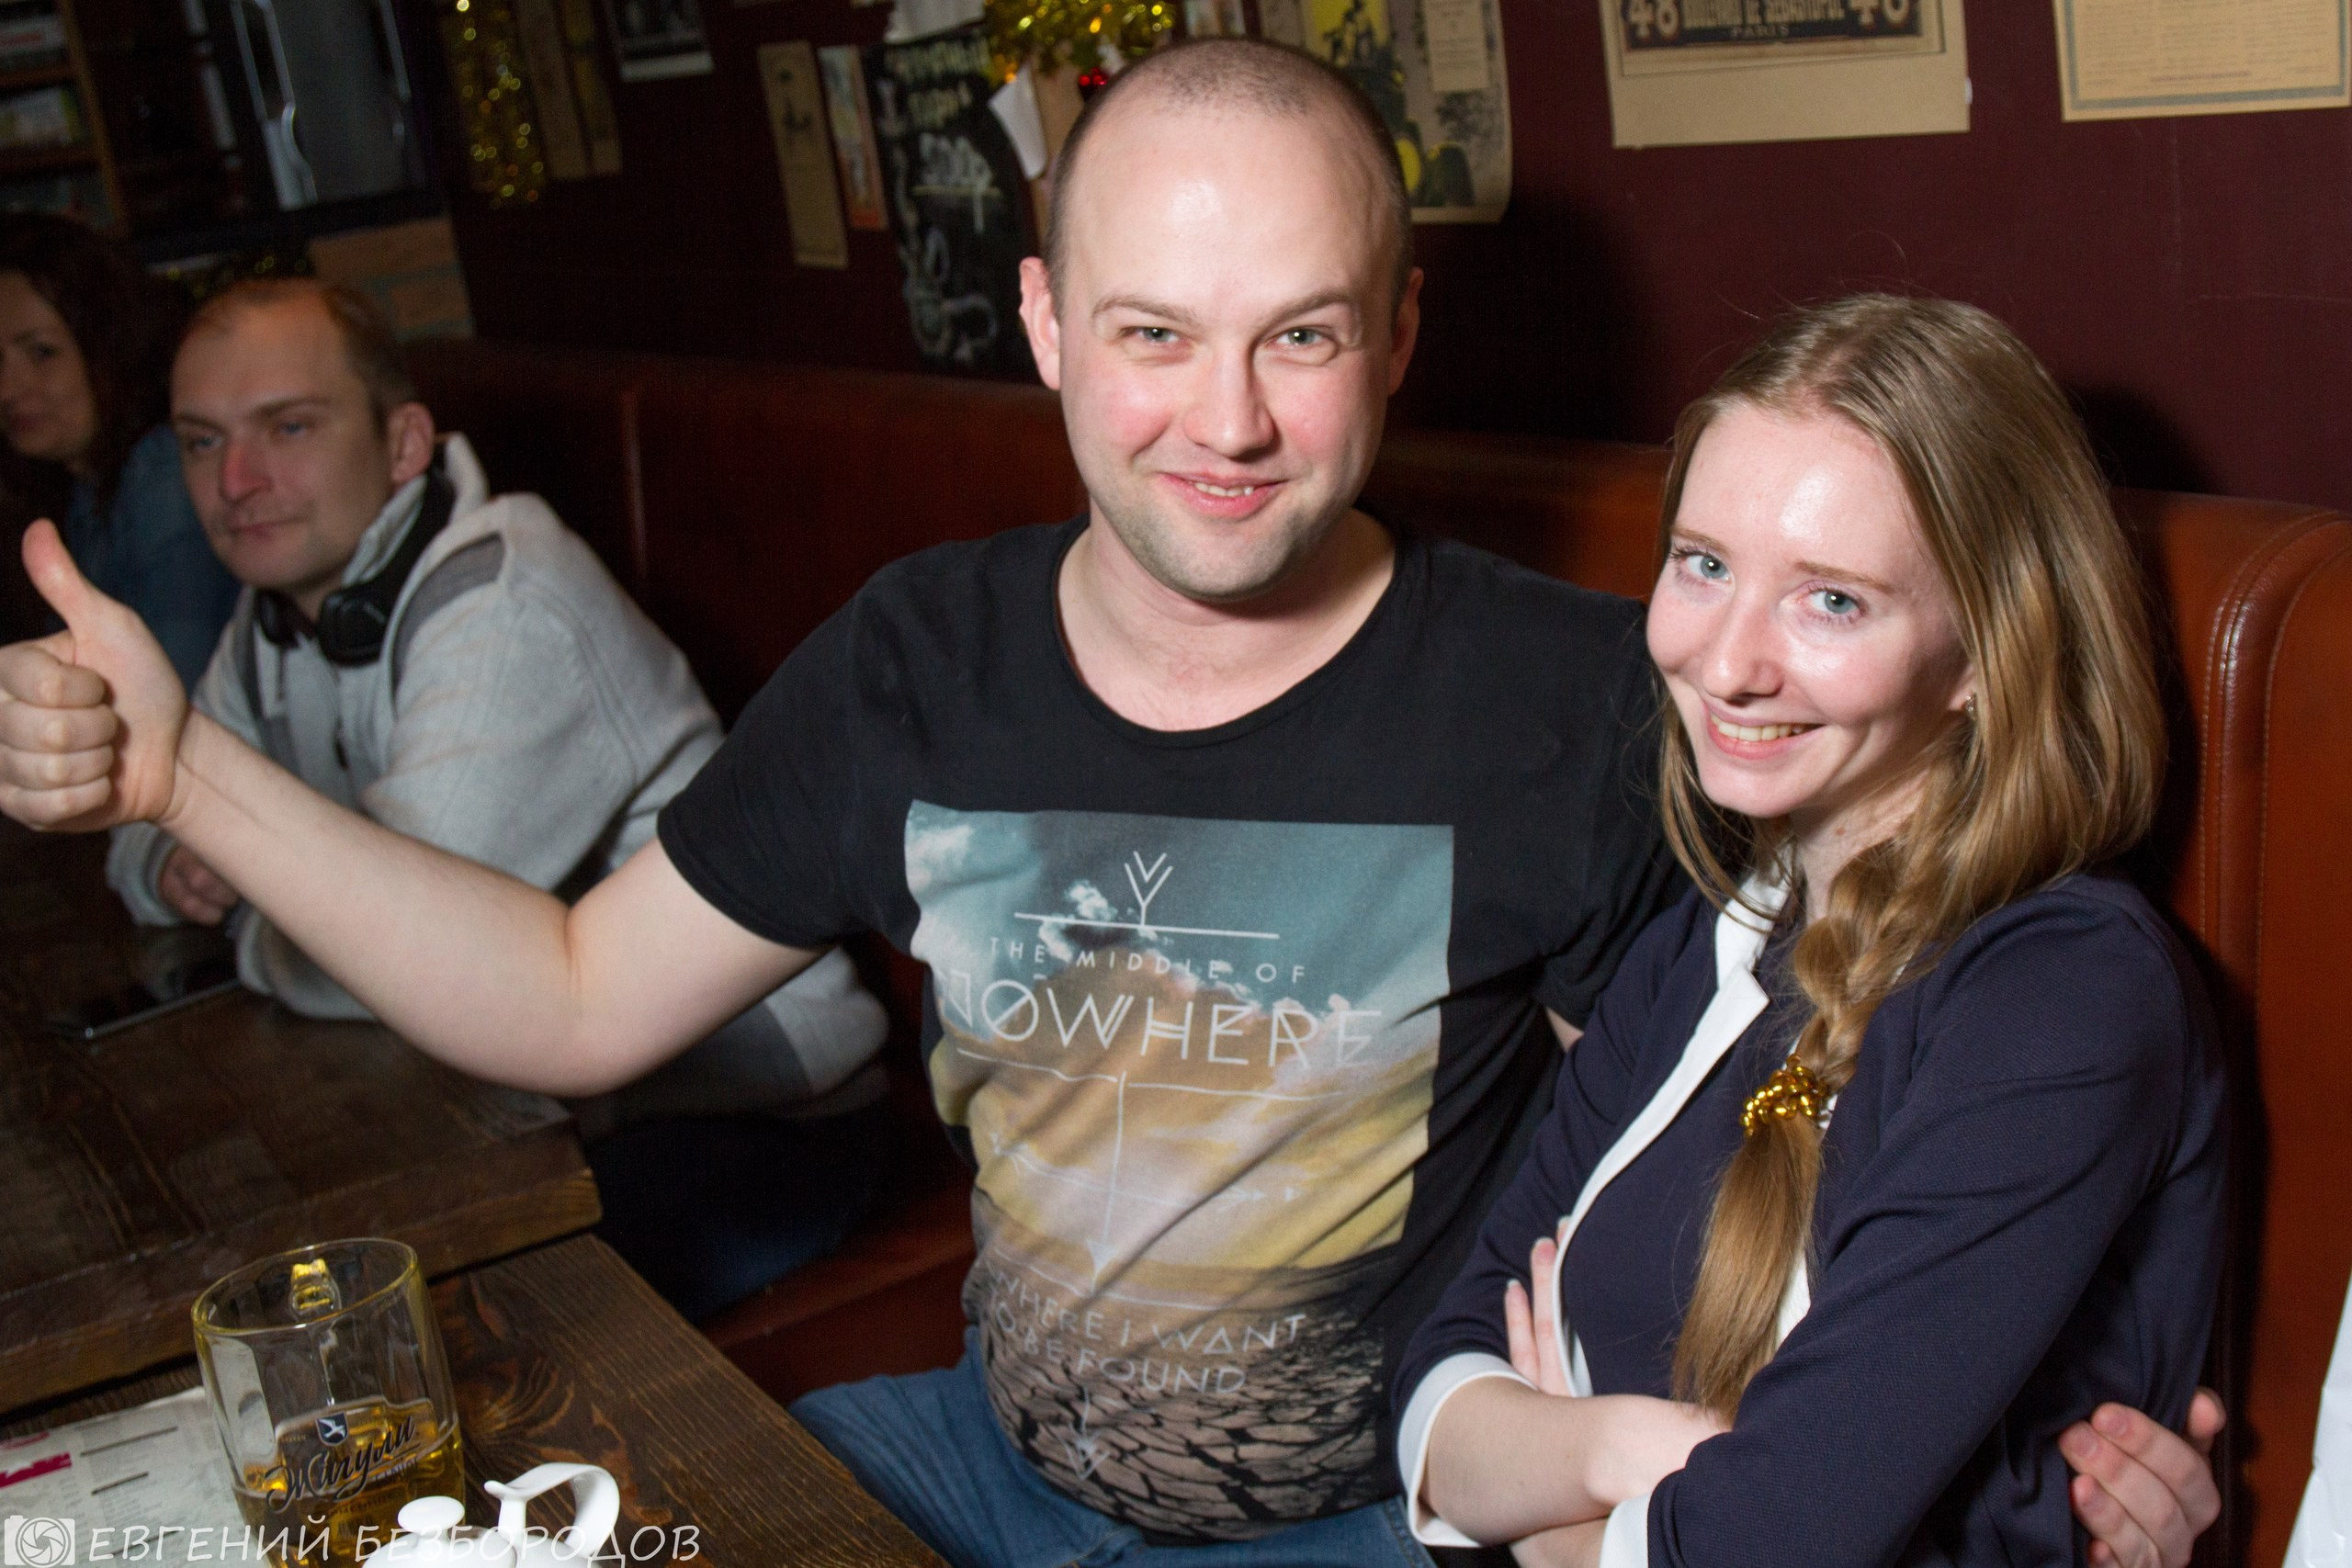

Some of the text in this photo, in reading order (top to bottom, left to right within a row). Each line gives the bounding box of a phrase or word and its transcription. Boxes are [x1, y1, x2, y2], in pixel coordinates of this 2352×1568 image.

[1729, 23, 1790, 39] PARIS
[990, 936, 1306, 984] THE MIDDLE OF
[937, 967, 1382, 1071] NOWHERE
[986, 1260, 1306, 1355] WHERE I WANT
[1076, 1348, 1247, 1394] FOUND
[265, 1416, 416, 1515] Жигули
